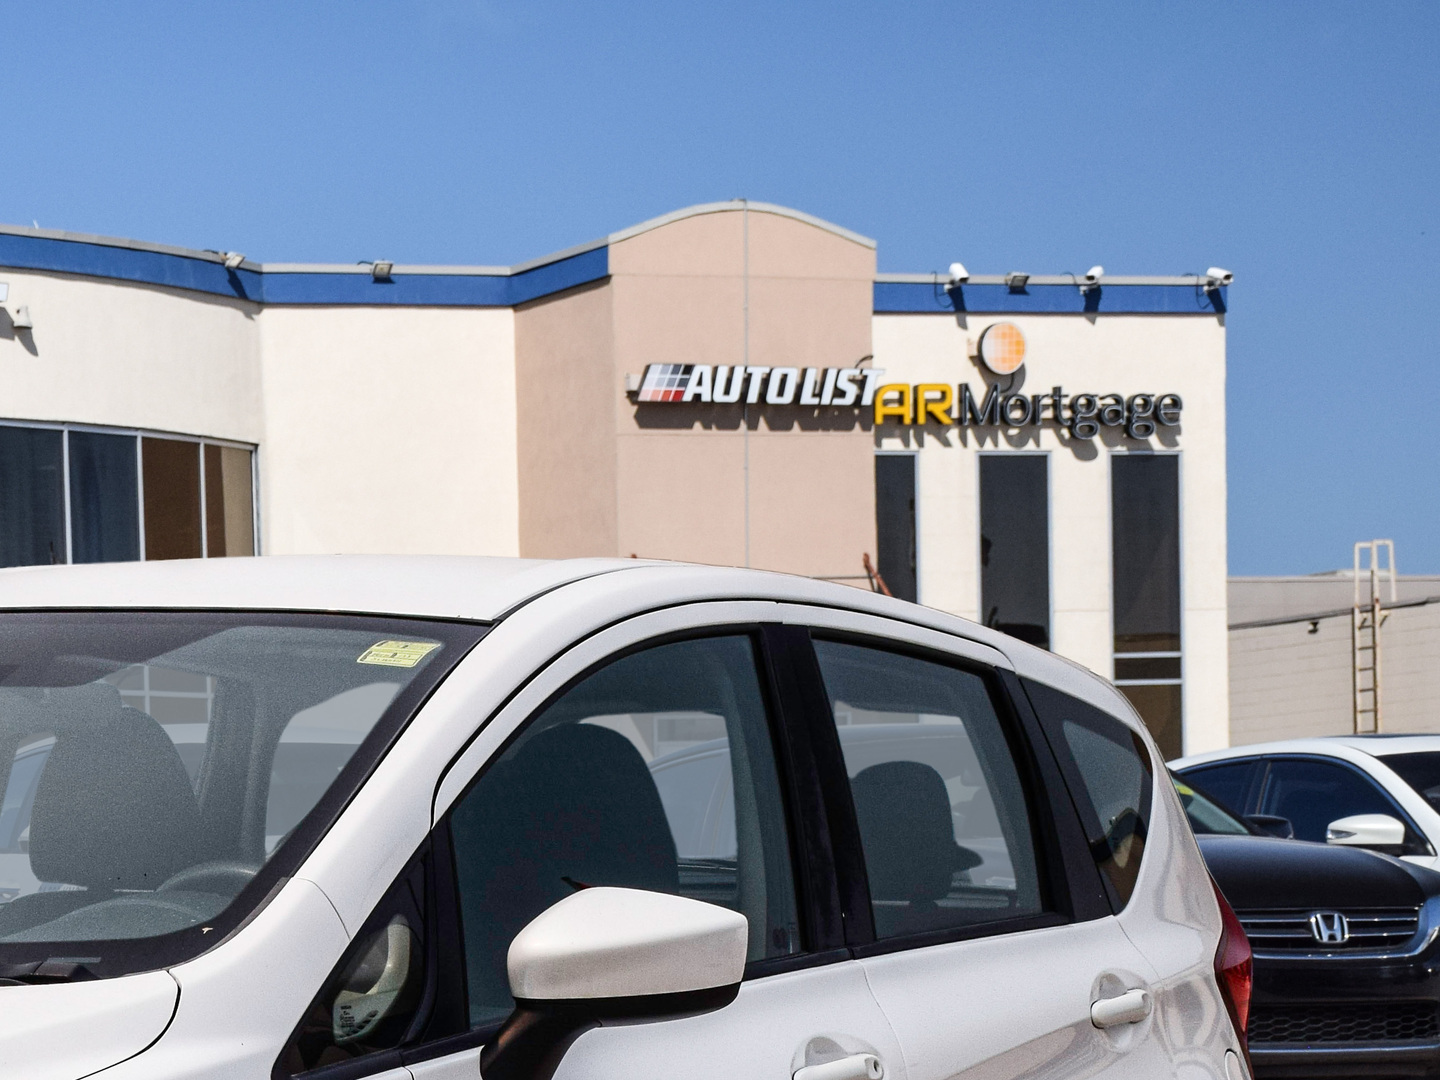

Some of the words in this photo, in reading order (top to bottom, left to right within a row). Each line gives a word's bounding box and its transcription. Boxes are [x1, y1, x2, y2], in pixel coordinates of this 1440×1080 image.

[682, 365, 798, 405] AUTO
[799, 366, 886, 407] LIST
[874, 383, 954, 426] AR
[960, 382, 1184, 440] Mortgage
